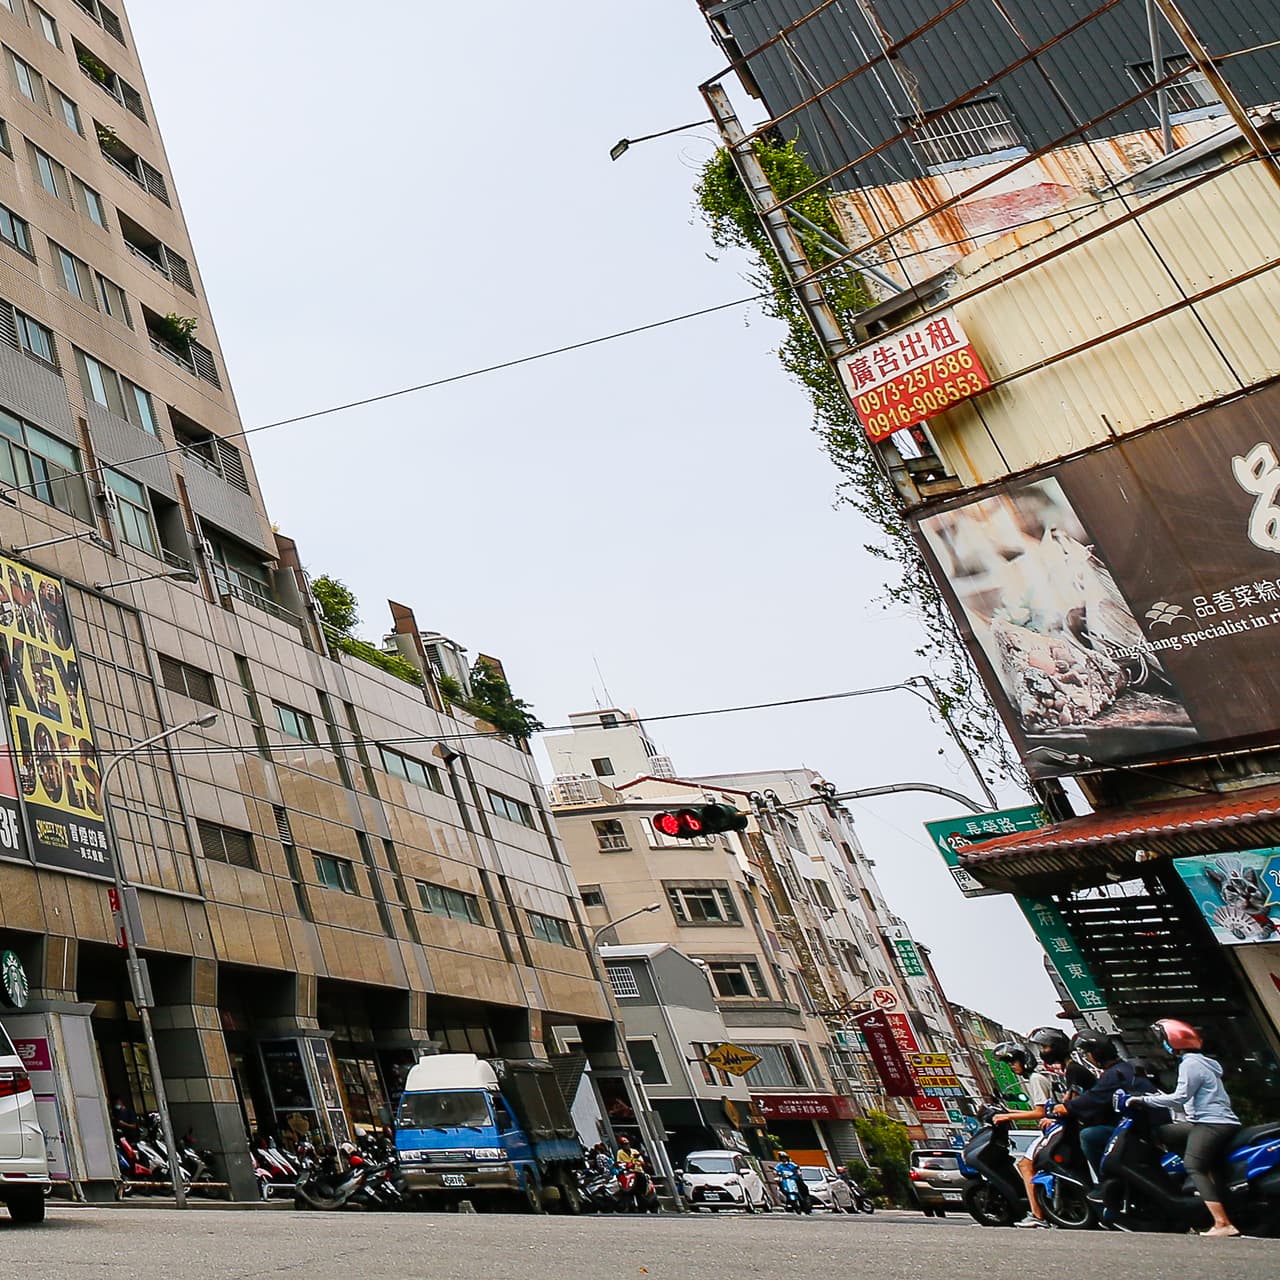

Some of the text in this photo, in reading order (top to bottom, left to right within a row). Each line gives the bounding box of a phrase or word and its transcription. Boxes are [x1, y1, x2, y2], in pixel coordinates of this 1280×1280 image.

[847, 316, 960, 390] 廣告出租
[858, 349, 972, 414] 0973-257586
[868, 373, 982, 436] 0916-908553
[1181, 619, 1250, 647] specialist
[1250, 614, 1270, 629] in
[1036, 911, 1102, 1006] 府連東路
